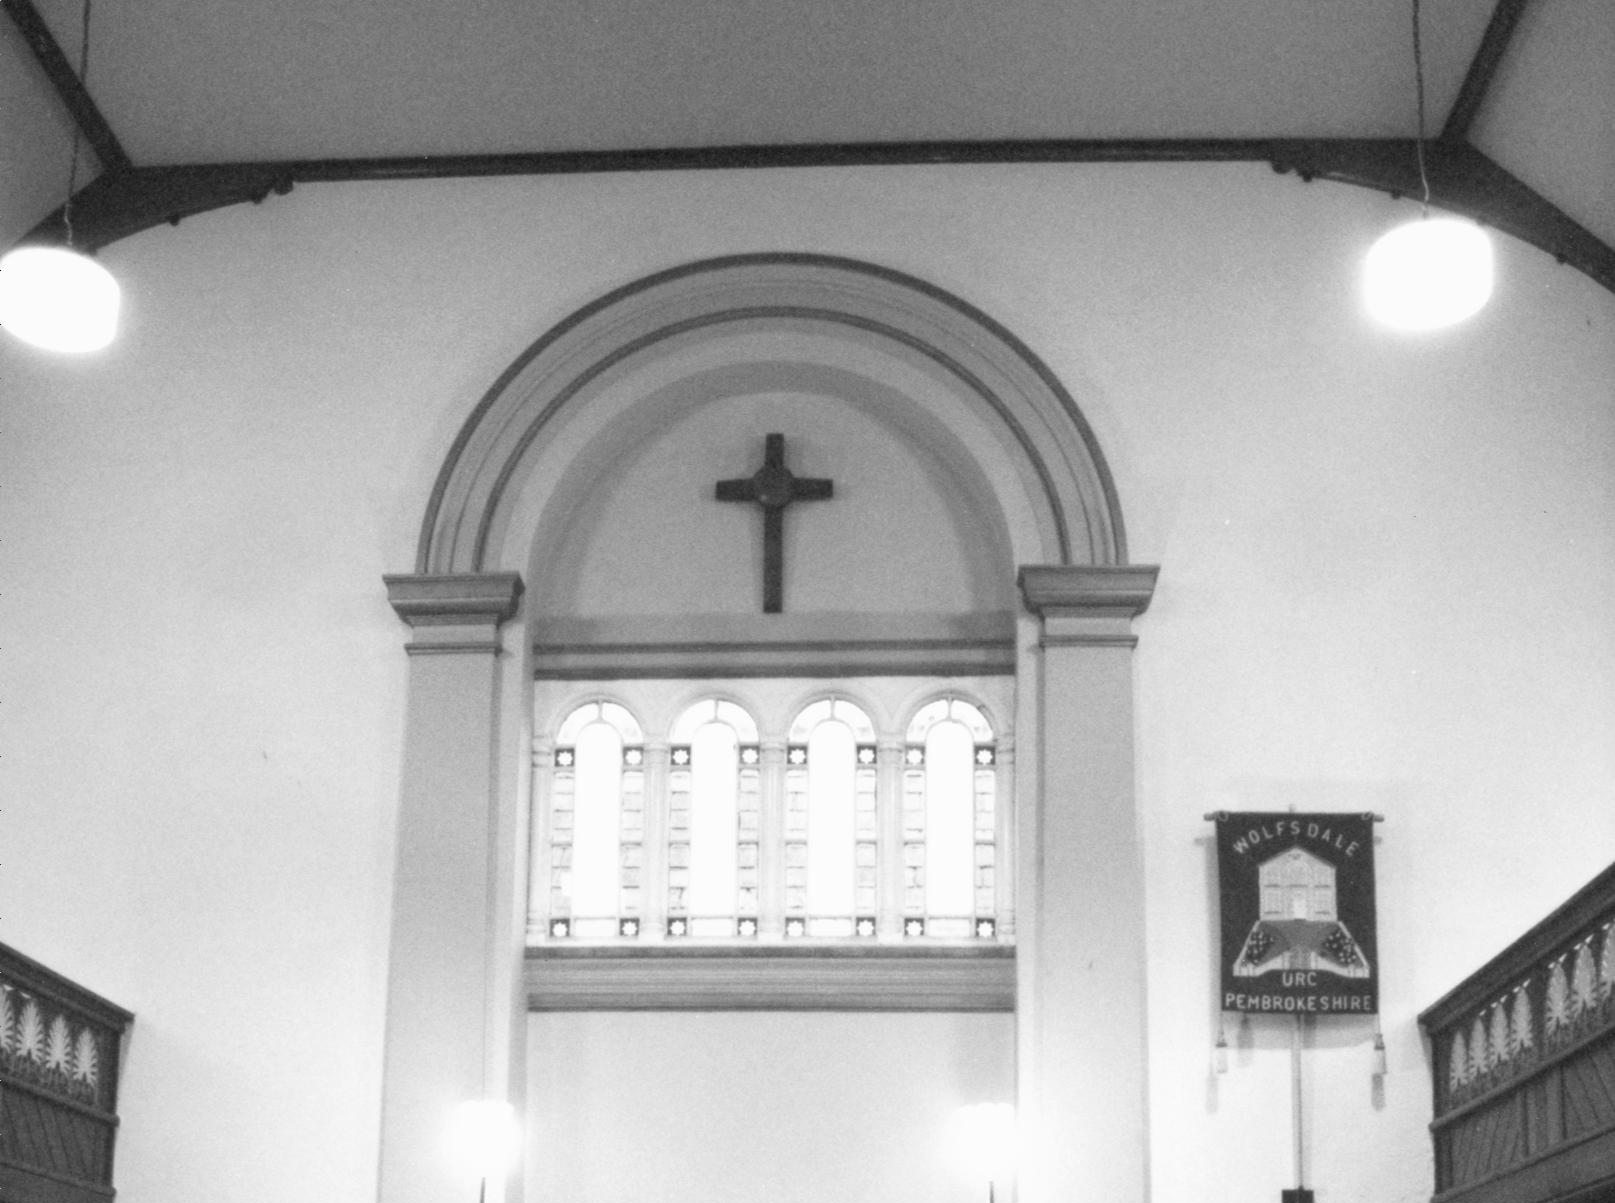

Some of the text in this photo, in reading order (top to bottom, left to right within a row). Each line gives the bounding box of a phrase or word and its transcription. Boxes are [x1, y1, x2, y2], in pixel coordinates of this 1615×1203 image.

[1232, 820, 1360, 857] WOLFSDALE
[1282, 971, 1318, 987] URC
[1225, 992, 1373, 1012] PEMBROKESHIRE
